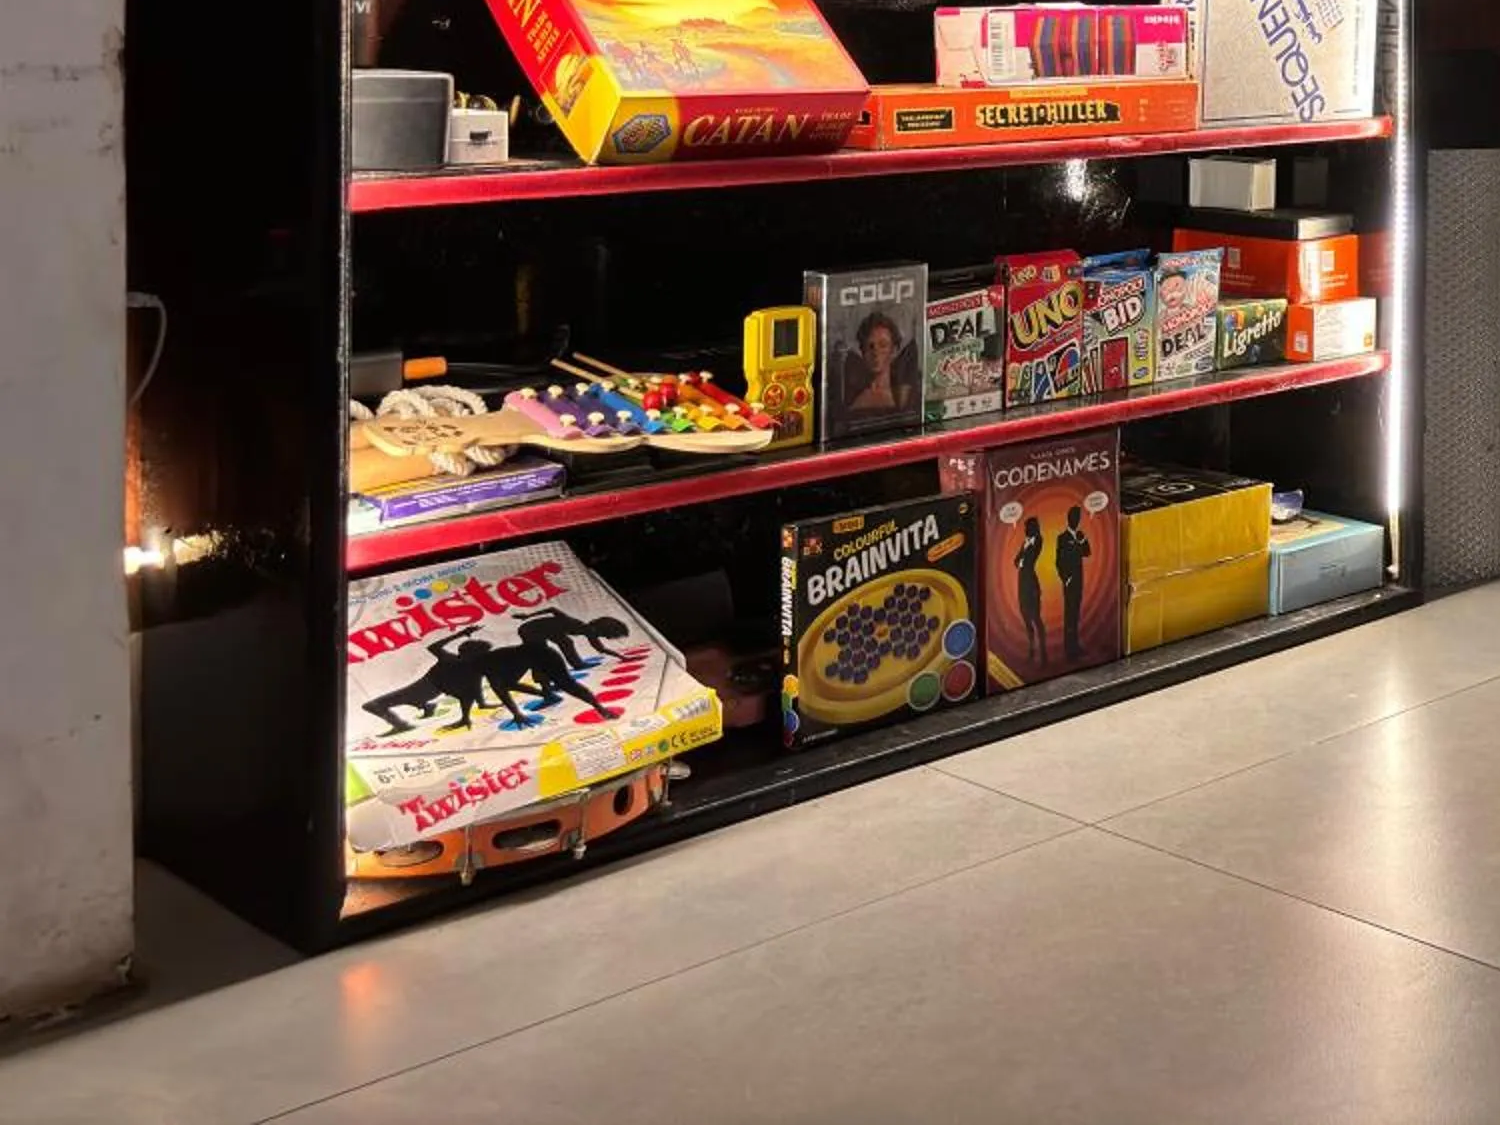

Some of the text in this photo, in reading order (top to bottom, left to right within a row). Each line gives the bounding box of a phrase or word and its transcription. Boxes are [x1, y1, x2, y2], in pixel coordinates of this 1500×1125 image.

[683, 114, 810, 147] CATAN
[976, 99, 1107, 127] SECRET HITLER
[929, 309, 992, 351] DEAL
[1011, 281, 1082, 348] UNO
[1102, 295, 1145, 335] BID
[1223, 310, 1282, 358] Ligretto
[1161, 324, 1207, 356] DEAL
[993, 450, 1112, 489] CODENAMES
[807, 513, 940, 606] BRAINVITA
[833, 519, 899, 561] COLOURFUL
[780, 556, 793, 636] BRAINVITA
[398, 758, 531, 833] Twister
